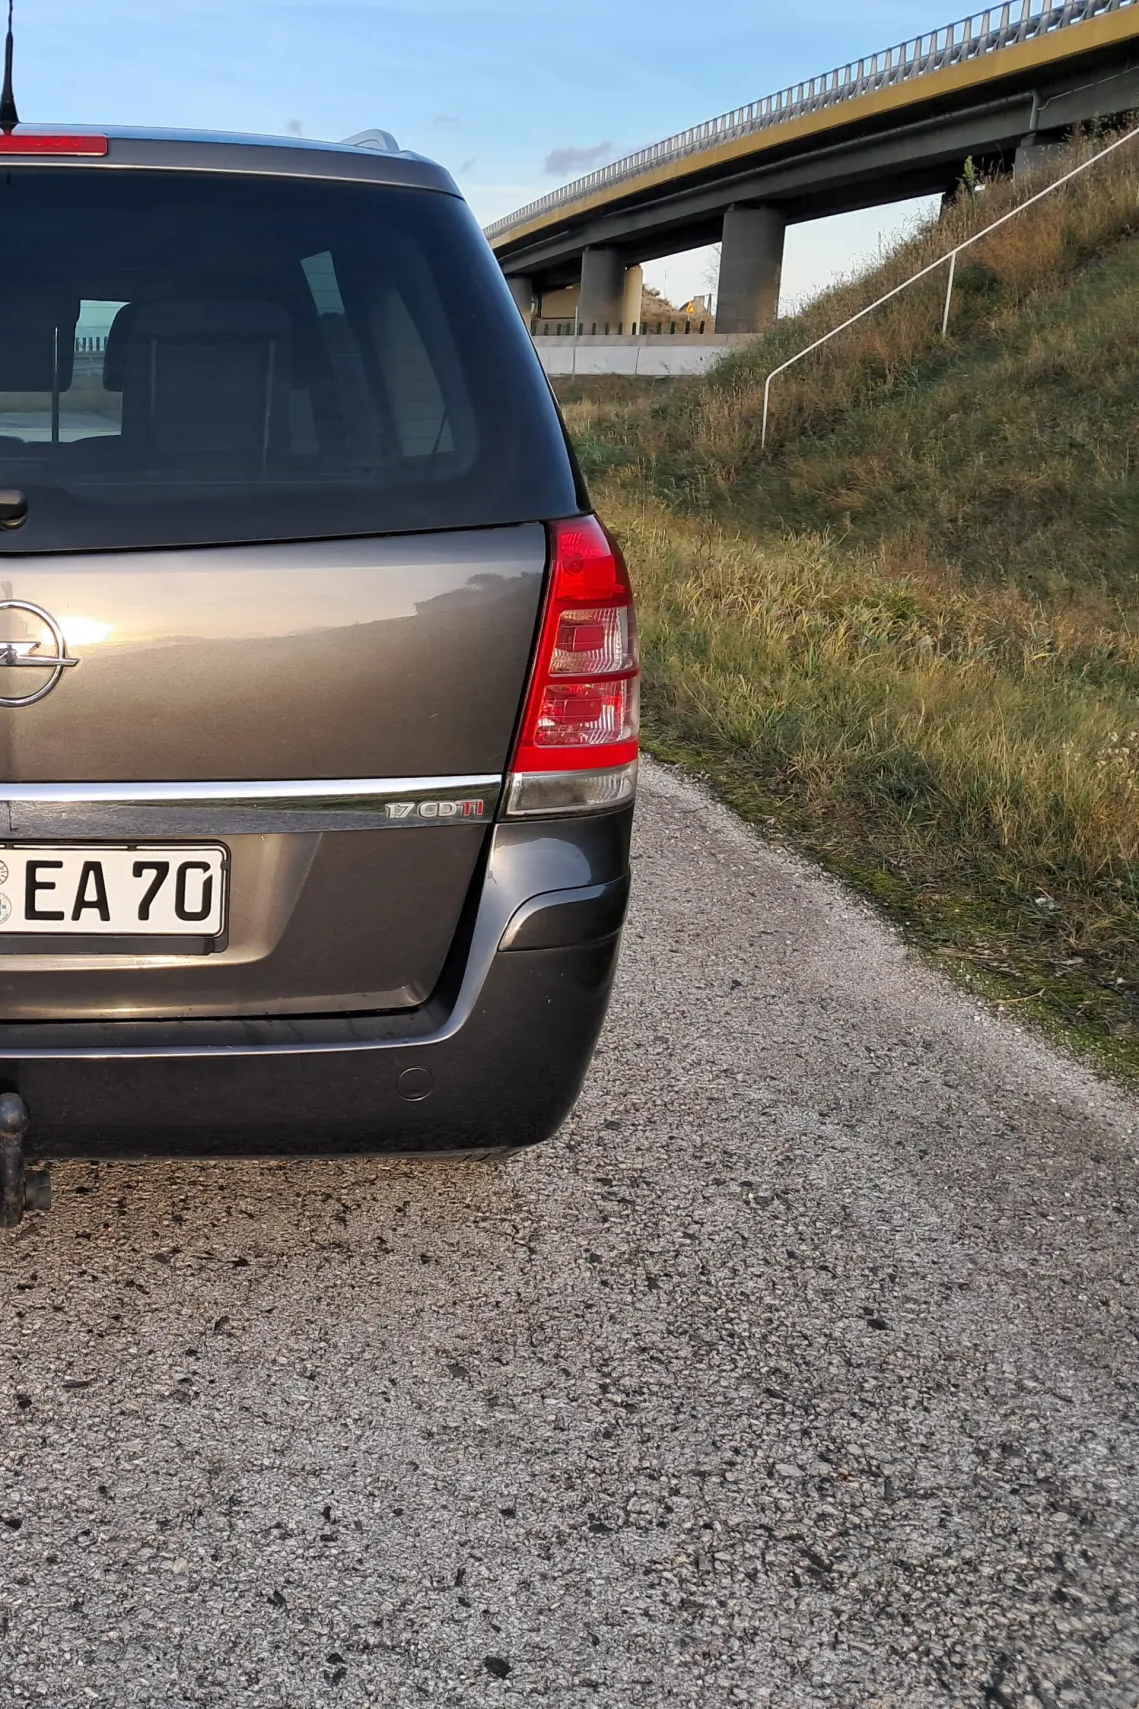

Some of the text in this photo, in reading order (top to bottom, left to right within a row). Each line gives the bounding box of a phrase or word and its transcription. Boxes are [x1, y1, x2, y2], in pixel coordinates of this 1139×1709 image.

[417, 799, 484, 819] CDTI
[24, 859, 111, 921] EA
[132, 860, 212, 921] 70
